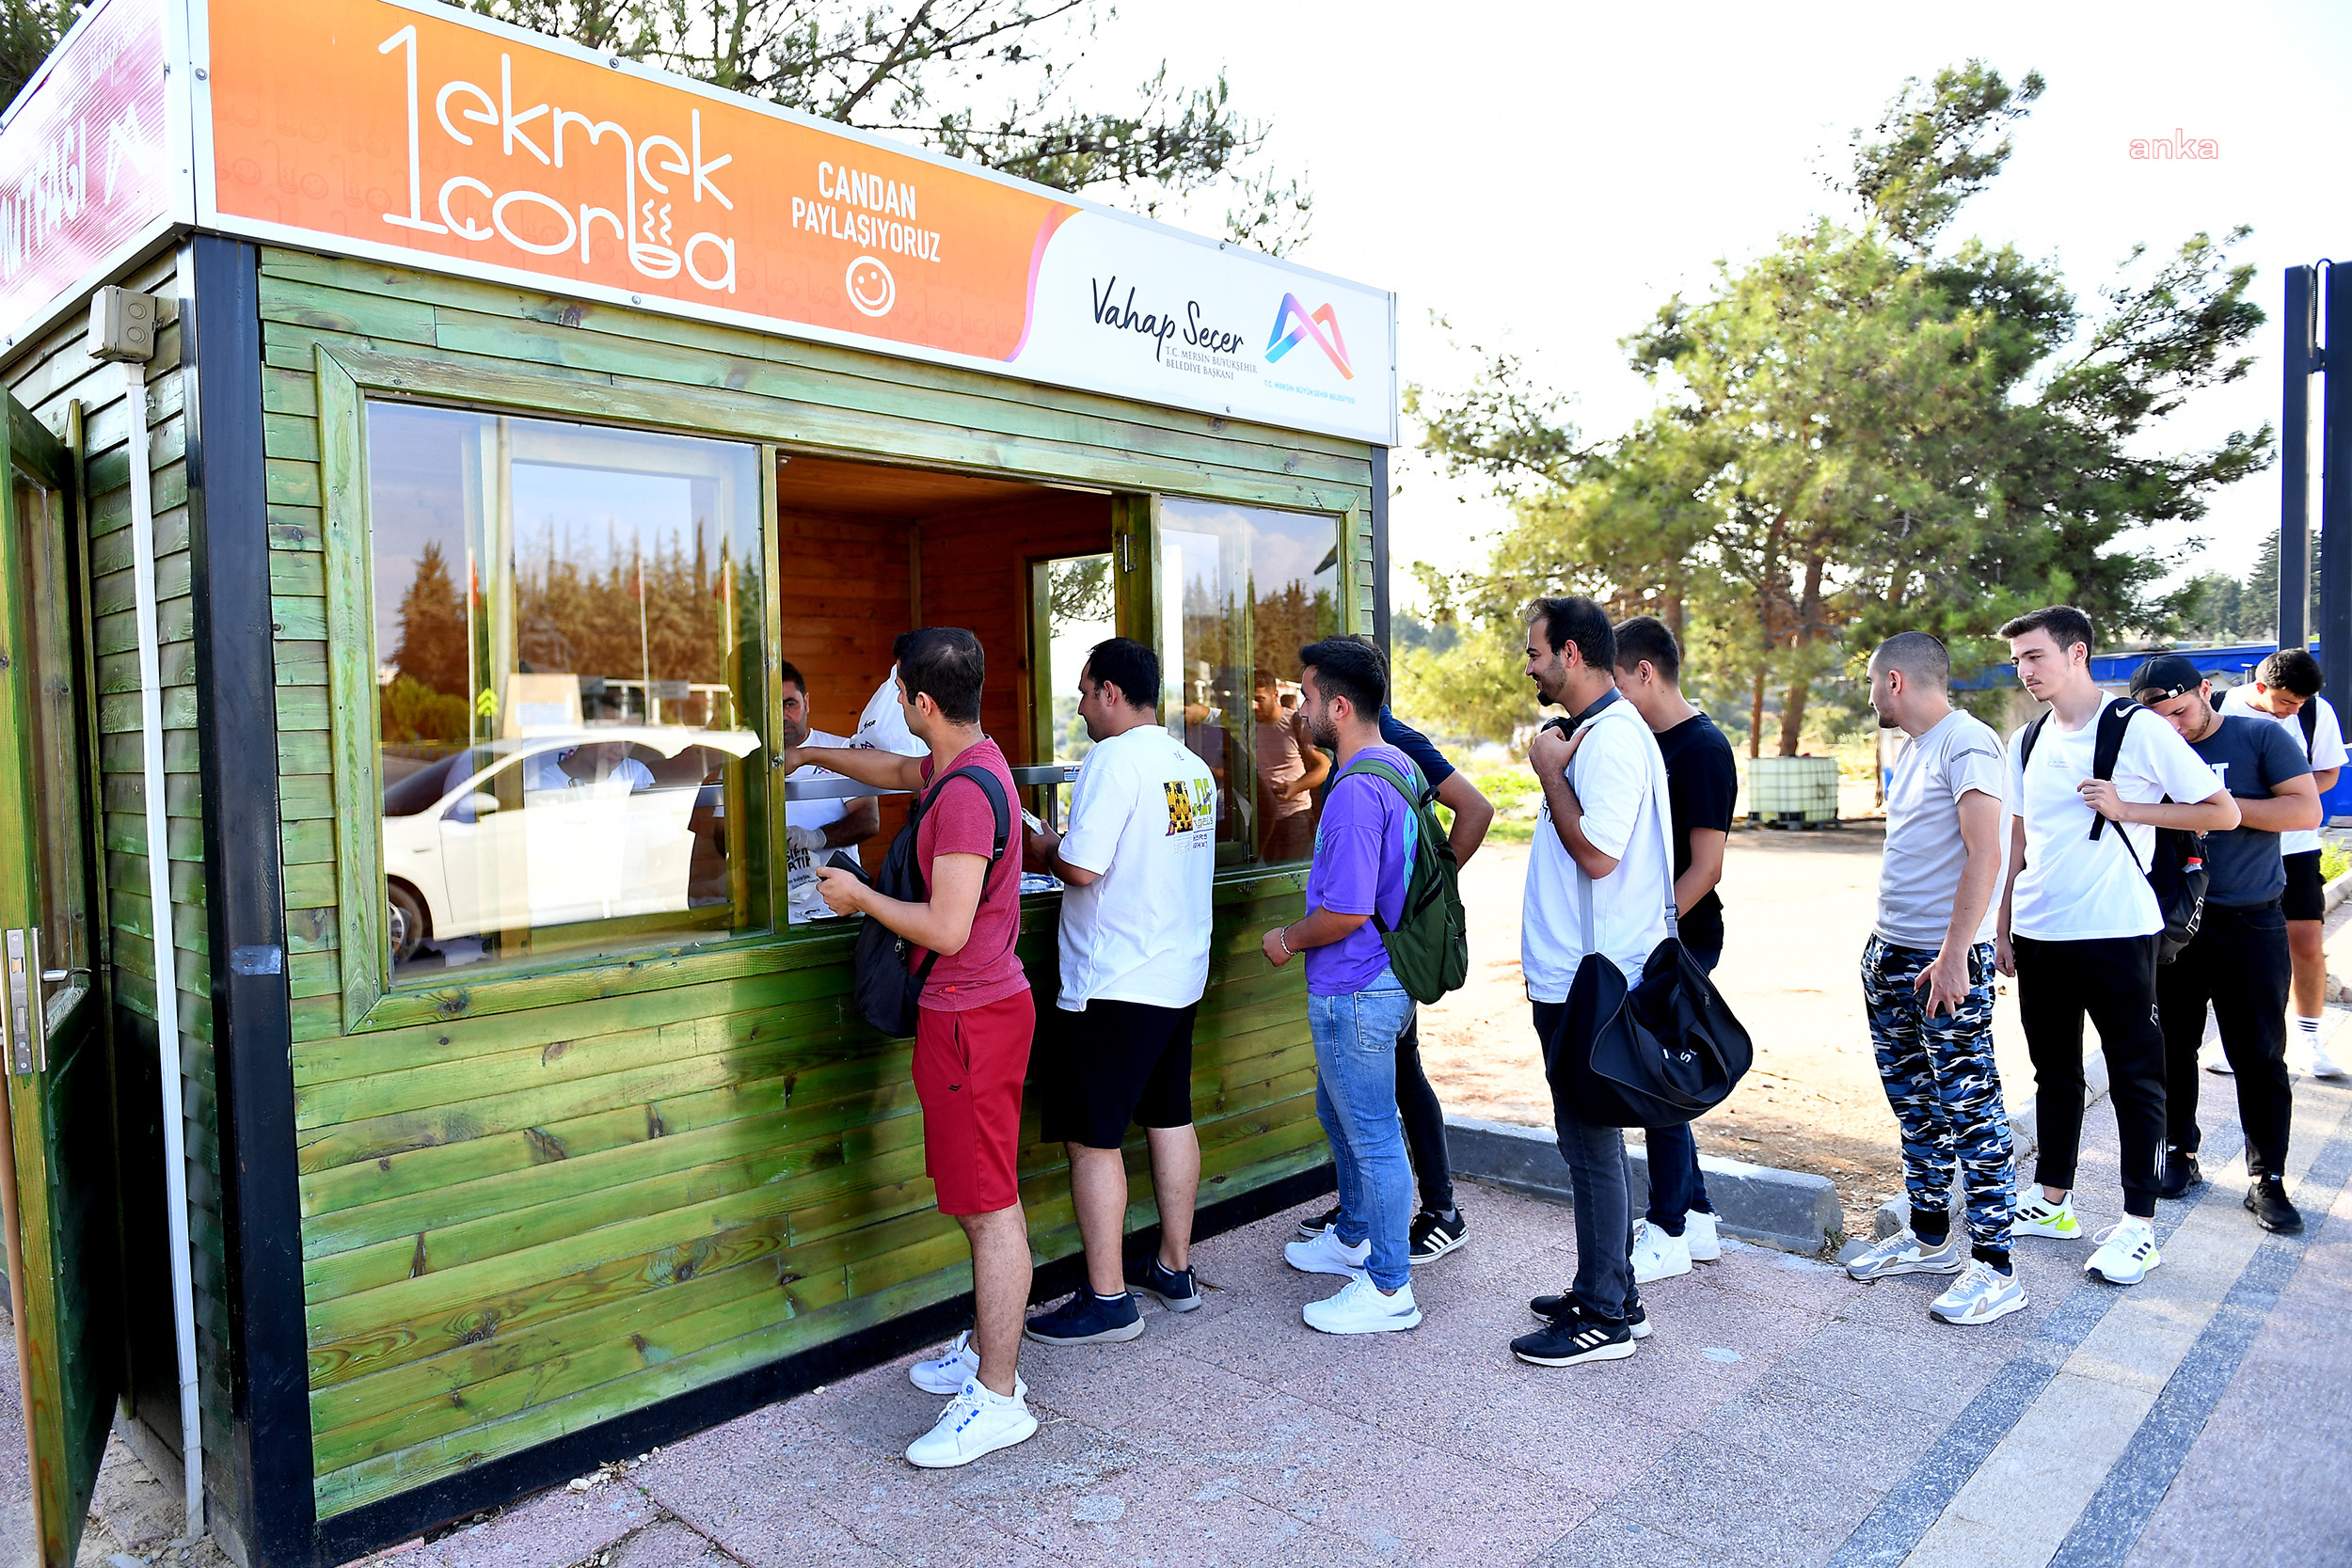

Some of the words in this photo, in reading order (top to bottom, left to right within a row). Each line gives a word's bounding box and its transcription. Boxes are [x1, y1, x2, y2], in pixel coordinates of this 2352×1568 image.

[436, 53, 734, 211] ekmek
[818, 161, 916, 221] CANDAN
[792, 196, 941, 263] PAYLAŞIYORUZ
[1092, 276, 1176, 362] Vahap
[1184, 300, 1244, 354] Seçer
[1166, 346, 1180, 357] T.C.
